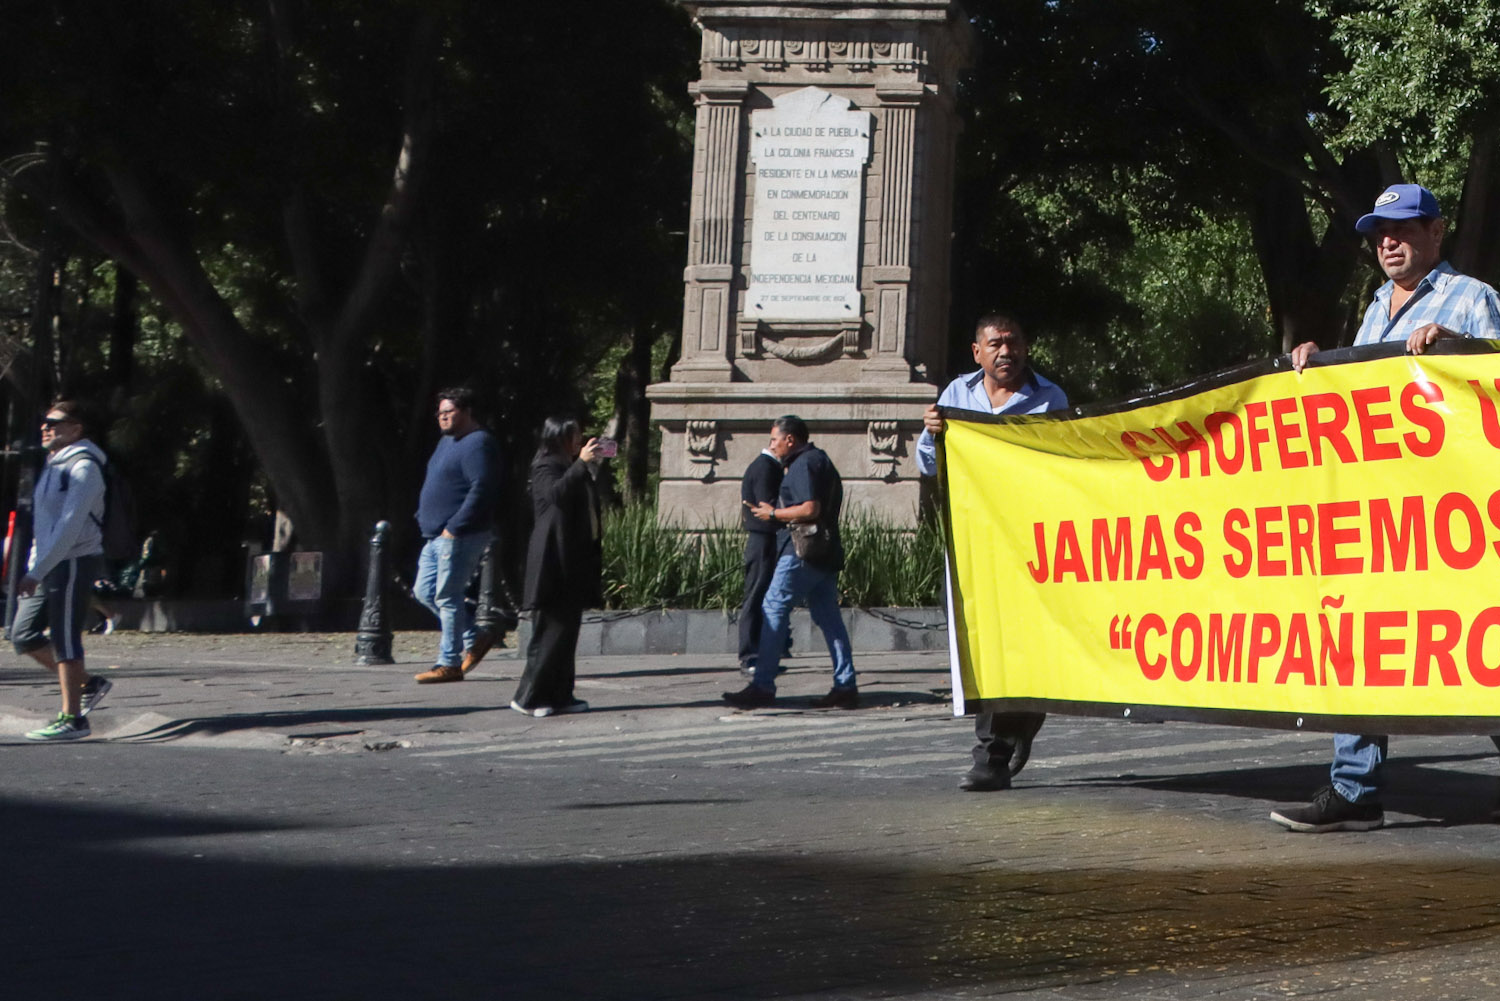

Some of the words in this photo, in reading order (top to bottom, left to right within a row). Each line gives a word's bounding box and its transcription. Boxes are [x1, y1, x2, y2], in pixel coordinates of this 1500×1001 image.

[762, 127, 767, 137] A
[770, 127, 781, 137] LA
[784, 127, 812, 137] CIUDAD
[815, 127, 825, 137] DE
[828, 127, 859, 137] PUEBLA
[764, 148, 775, 158] LA
[778, 148, 811, 158] COLONIA
[814, 148, 855, 158] FRANCESA
[758, 169, 801, 179] RESIDENTE
[804, 169, 815, 179] EN
[818, 169, 828, 179] LA
[831, 169, 858, 179] MISMA
[767, 189, 778, 199] EN
[773, 211, 789, 221] DEL
[792, 211, 840, 221] CENTENARIO
[764, 231, 775, 241] DE
[778, 231, 788, 241] LA
[791, 231, 847, 241] CONSUMACION
[792, 253, 803, 263] DE
[806, 253, 817, 263] LA
[751, 273, 812, 284] INDEPENDENCIA
[815, 273, 855, 284] MEXICANA
[1122, 382, 1445, 482] CHOFERES
[1027, 512, 1204, 584] JAMAS
